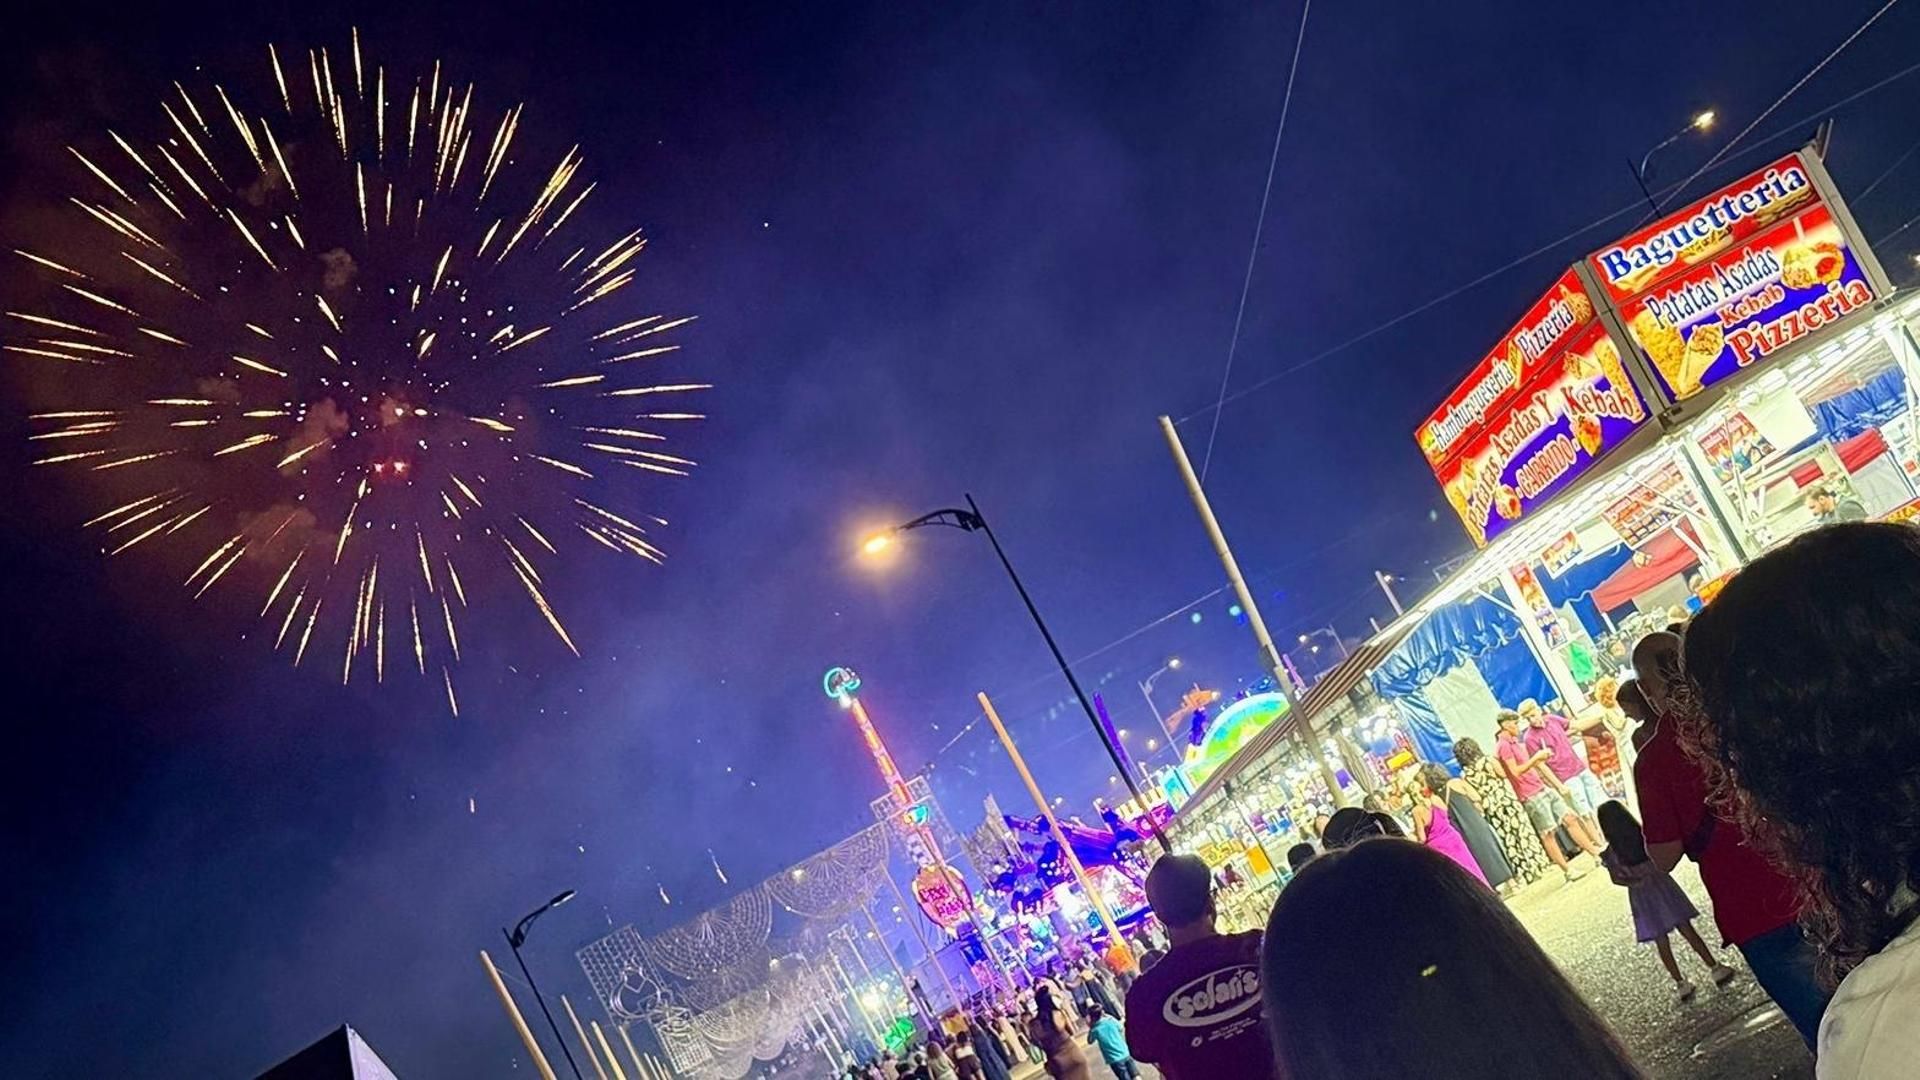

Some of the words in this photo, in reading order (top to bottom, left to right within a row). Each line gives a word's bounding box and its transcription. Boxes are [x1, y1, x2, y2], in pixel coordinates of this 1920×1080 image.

[1645, 282, 1718, 328] Patatas
[1712, 247, 1781, 299] Asadas
[1718, 285, 1785, 327] Kebab
[1492, 408, 1541, 464] Asadas
[1535, 391, 1556, 422] Y
[1560, 384, 1633, 417] Kebab
